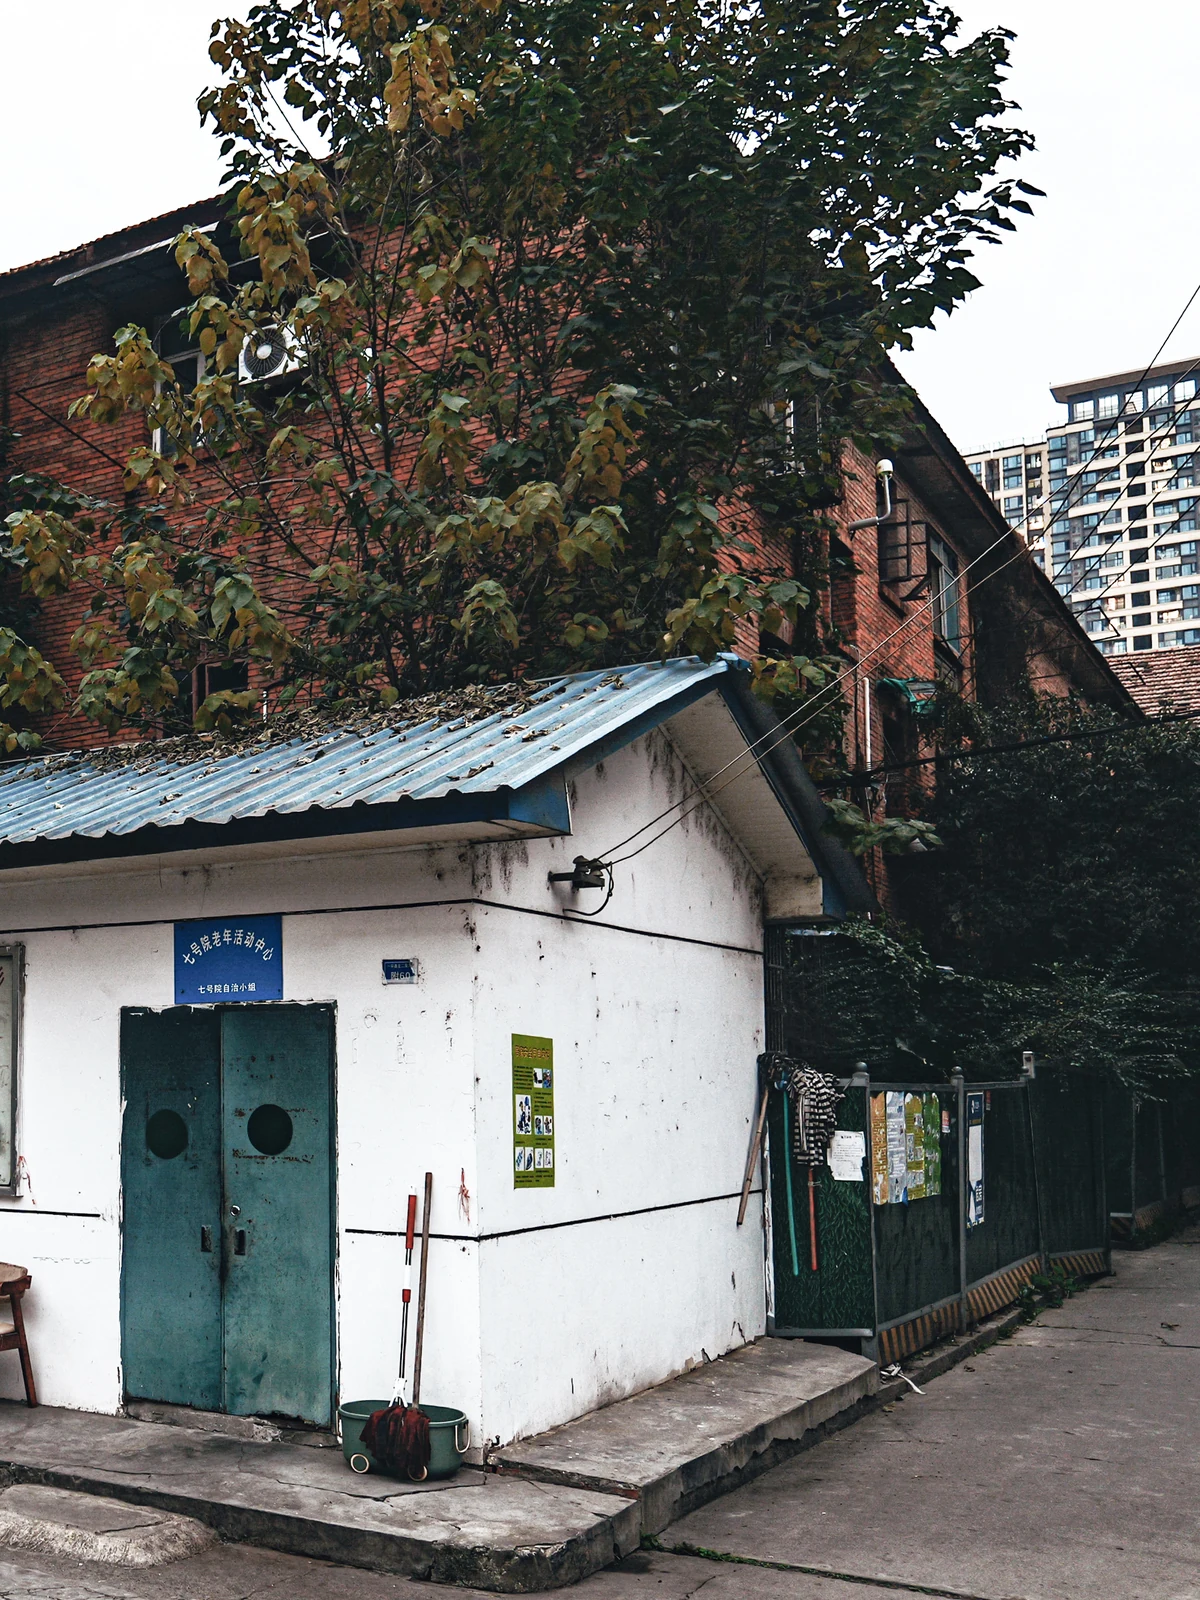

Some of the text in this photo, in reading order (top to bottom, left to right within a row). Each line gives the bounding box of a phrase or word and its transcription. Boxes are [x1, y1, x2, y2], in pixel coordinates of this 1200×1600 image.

[182, 929, 274, 965] 七号院老年活动中心
[197, 982, 257, 994] 七号院自治小组
